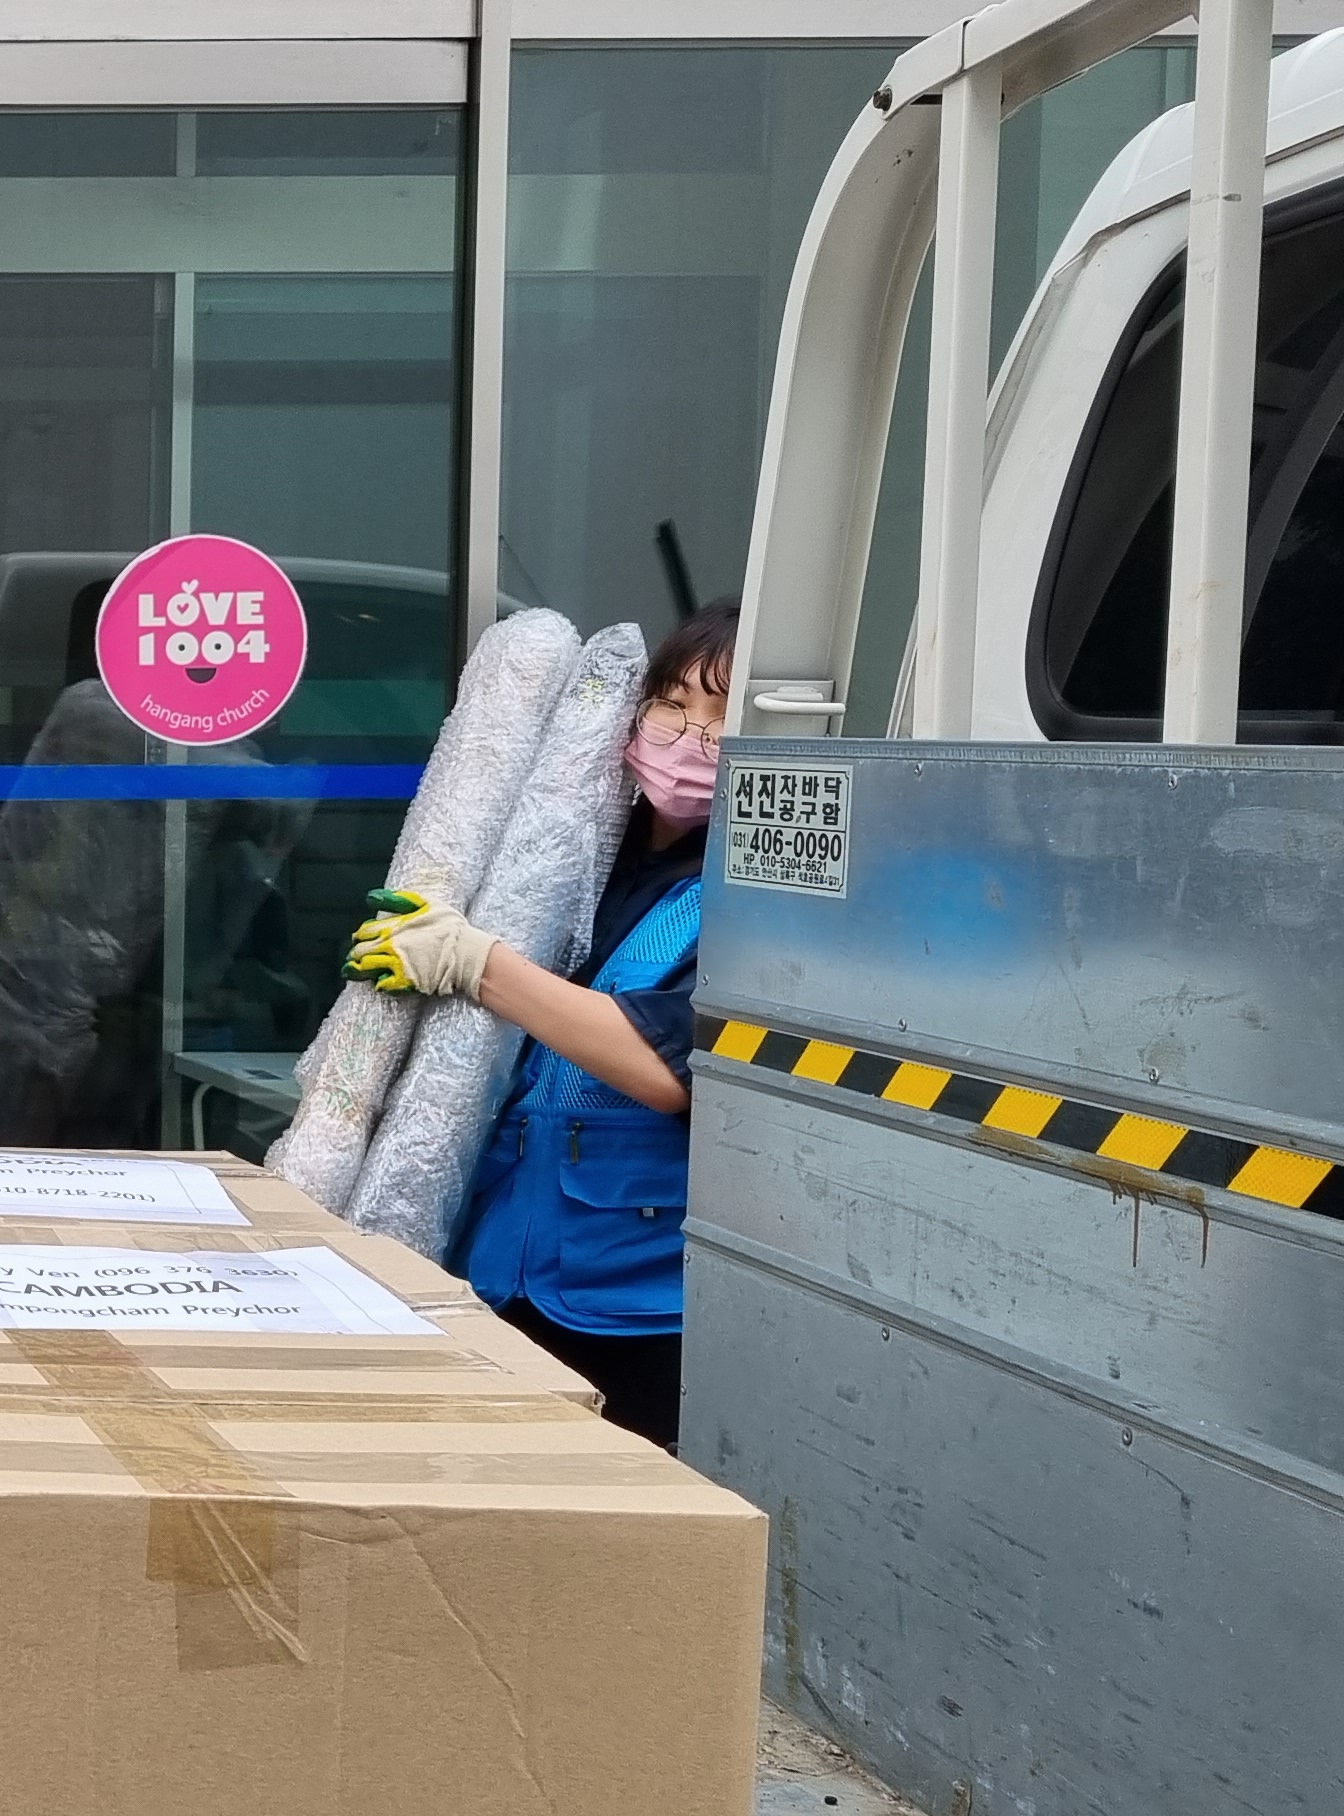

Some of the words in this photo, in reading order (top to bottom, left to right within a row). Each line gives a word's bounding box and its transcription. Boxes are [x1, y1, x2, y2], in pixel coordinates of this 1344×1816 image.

[138, 590, 265, 627] LOVE
[138, 630, 270, 666] 1004
[140, 694, 213, 733] hangang
[216, 688, 270, 726] church
[735, 772, 777, 819] 선진
[778, 799, 841, 825] 공구함
[749, 827, 842, 862] 406-0090
[760, 855, 827, 873] 010-5304-6621
[26, 1167, 128, 1177] Preychor
[27, 1267, 80, 1278] Ven
[94, 1266, 151, 1278] (096
[163, 1265, 214, 1275] 376
[181, 1302, 302, 1317] Preychor
